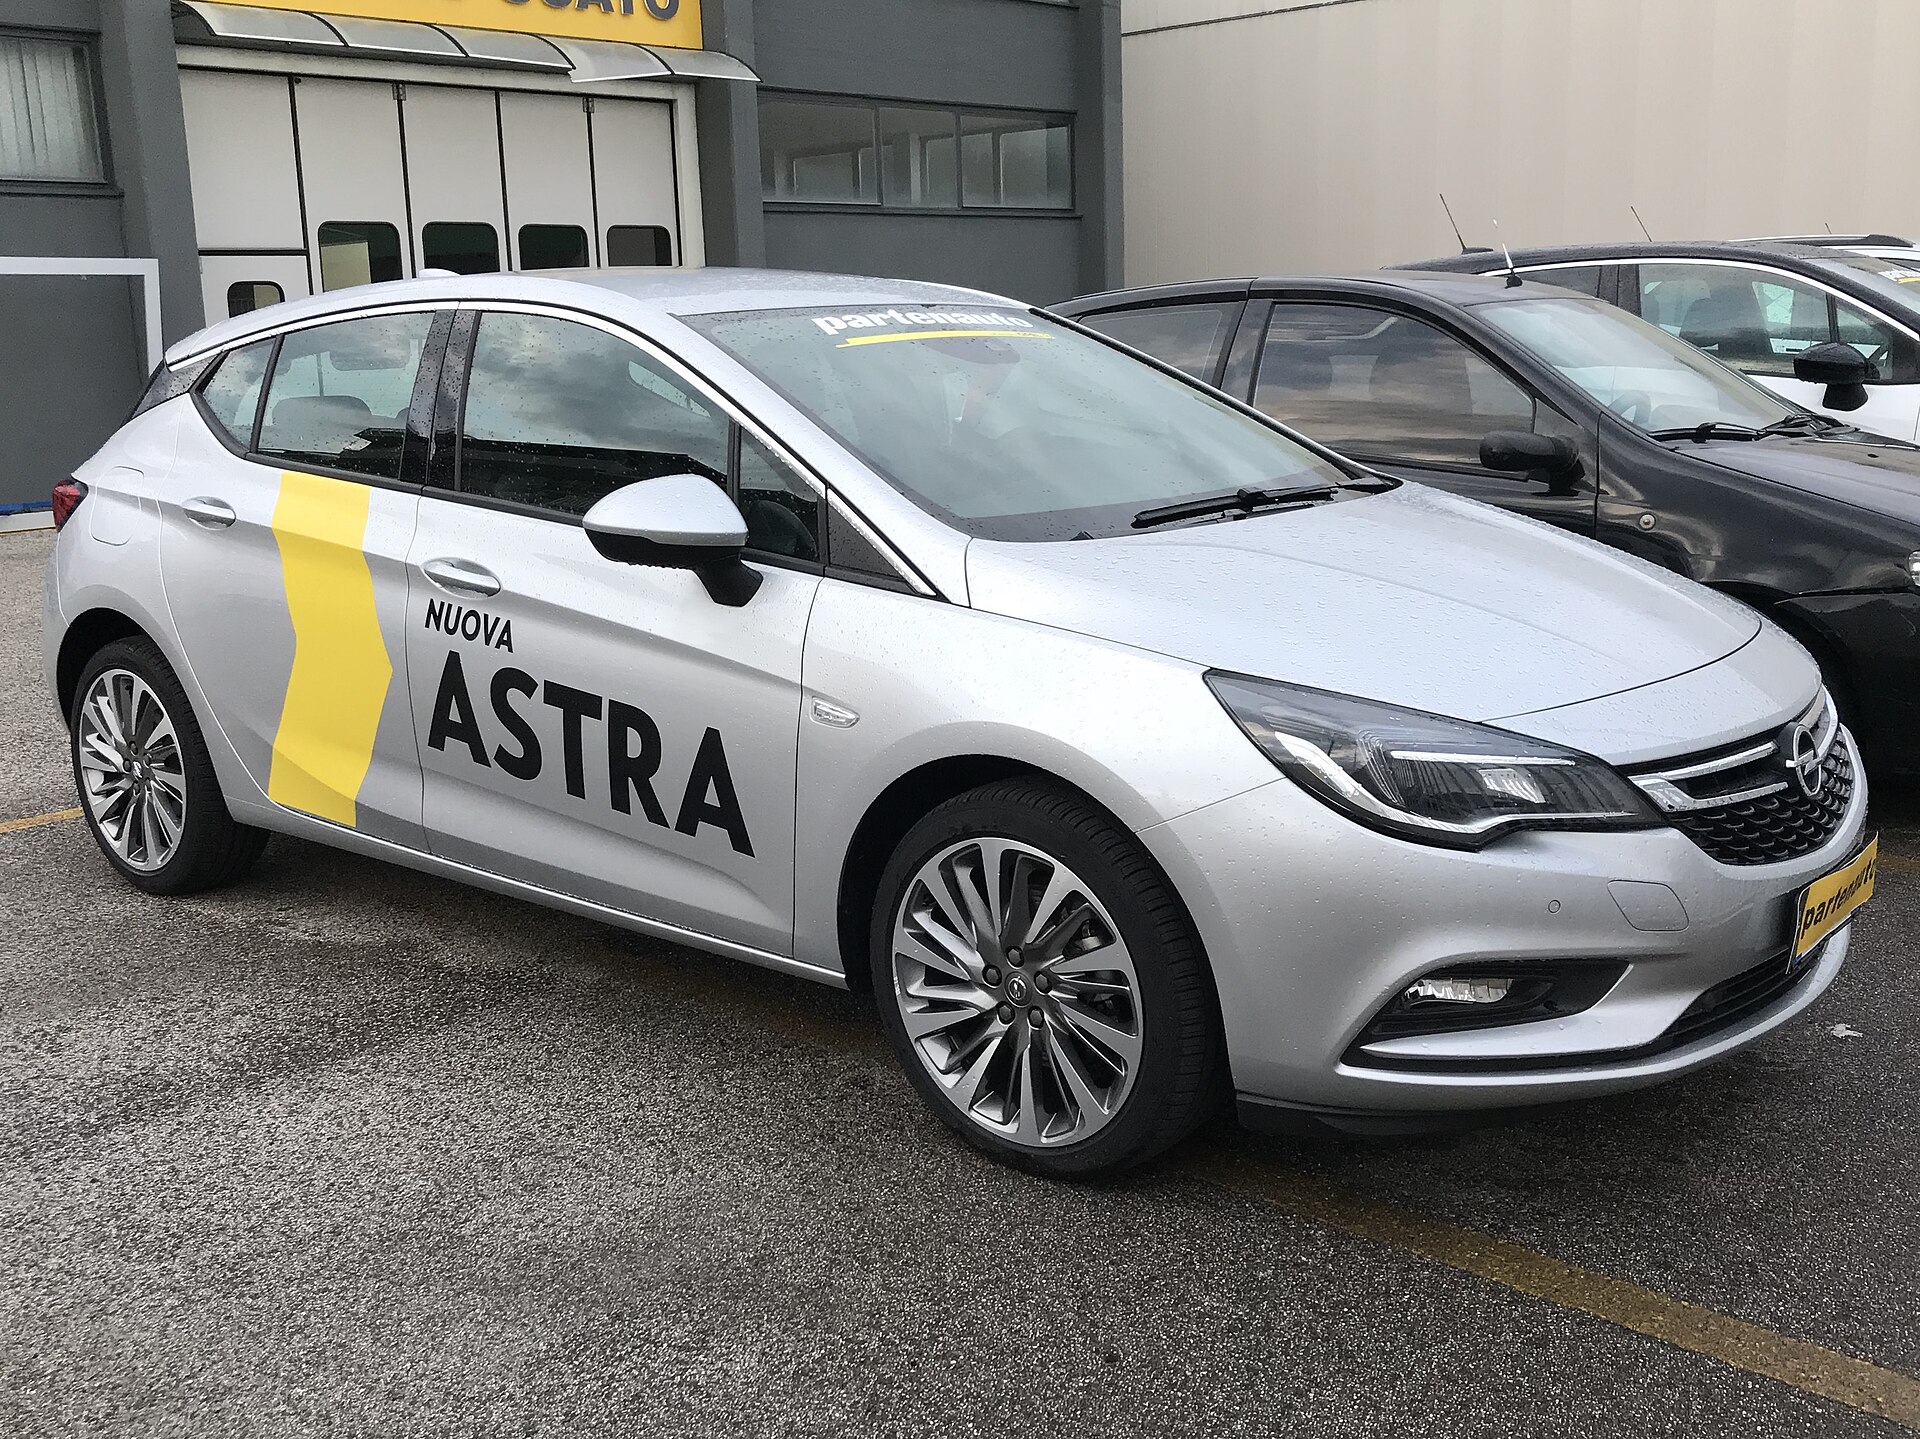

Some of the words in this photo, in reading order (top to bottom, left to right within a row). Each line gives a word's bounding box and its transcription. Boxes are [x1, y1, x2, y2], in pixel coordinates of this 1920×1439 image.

[812, 309, 1034, 335] partenauto
[425, 598, 514, 653] NUOVA
[427, 650, 756, 858] ASTRA
